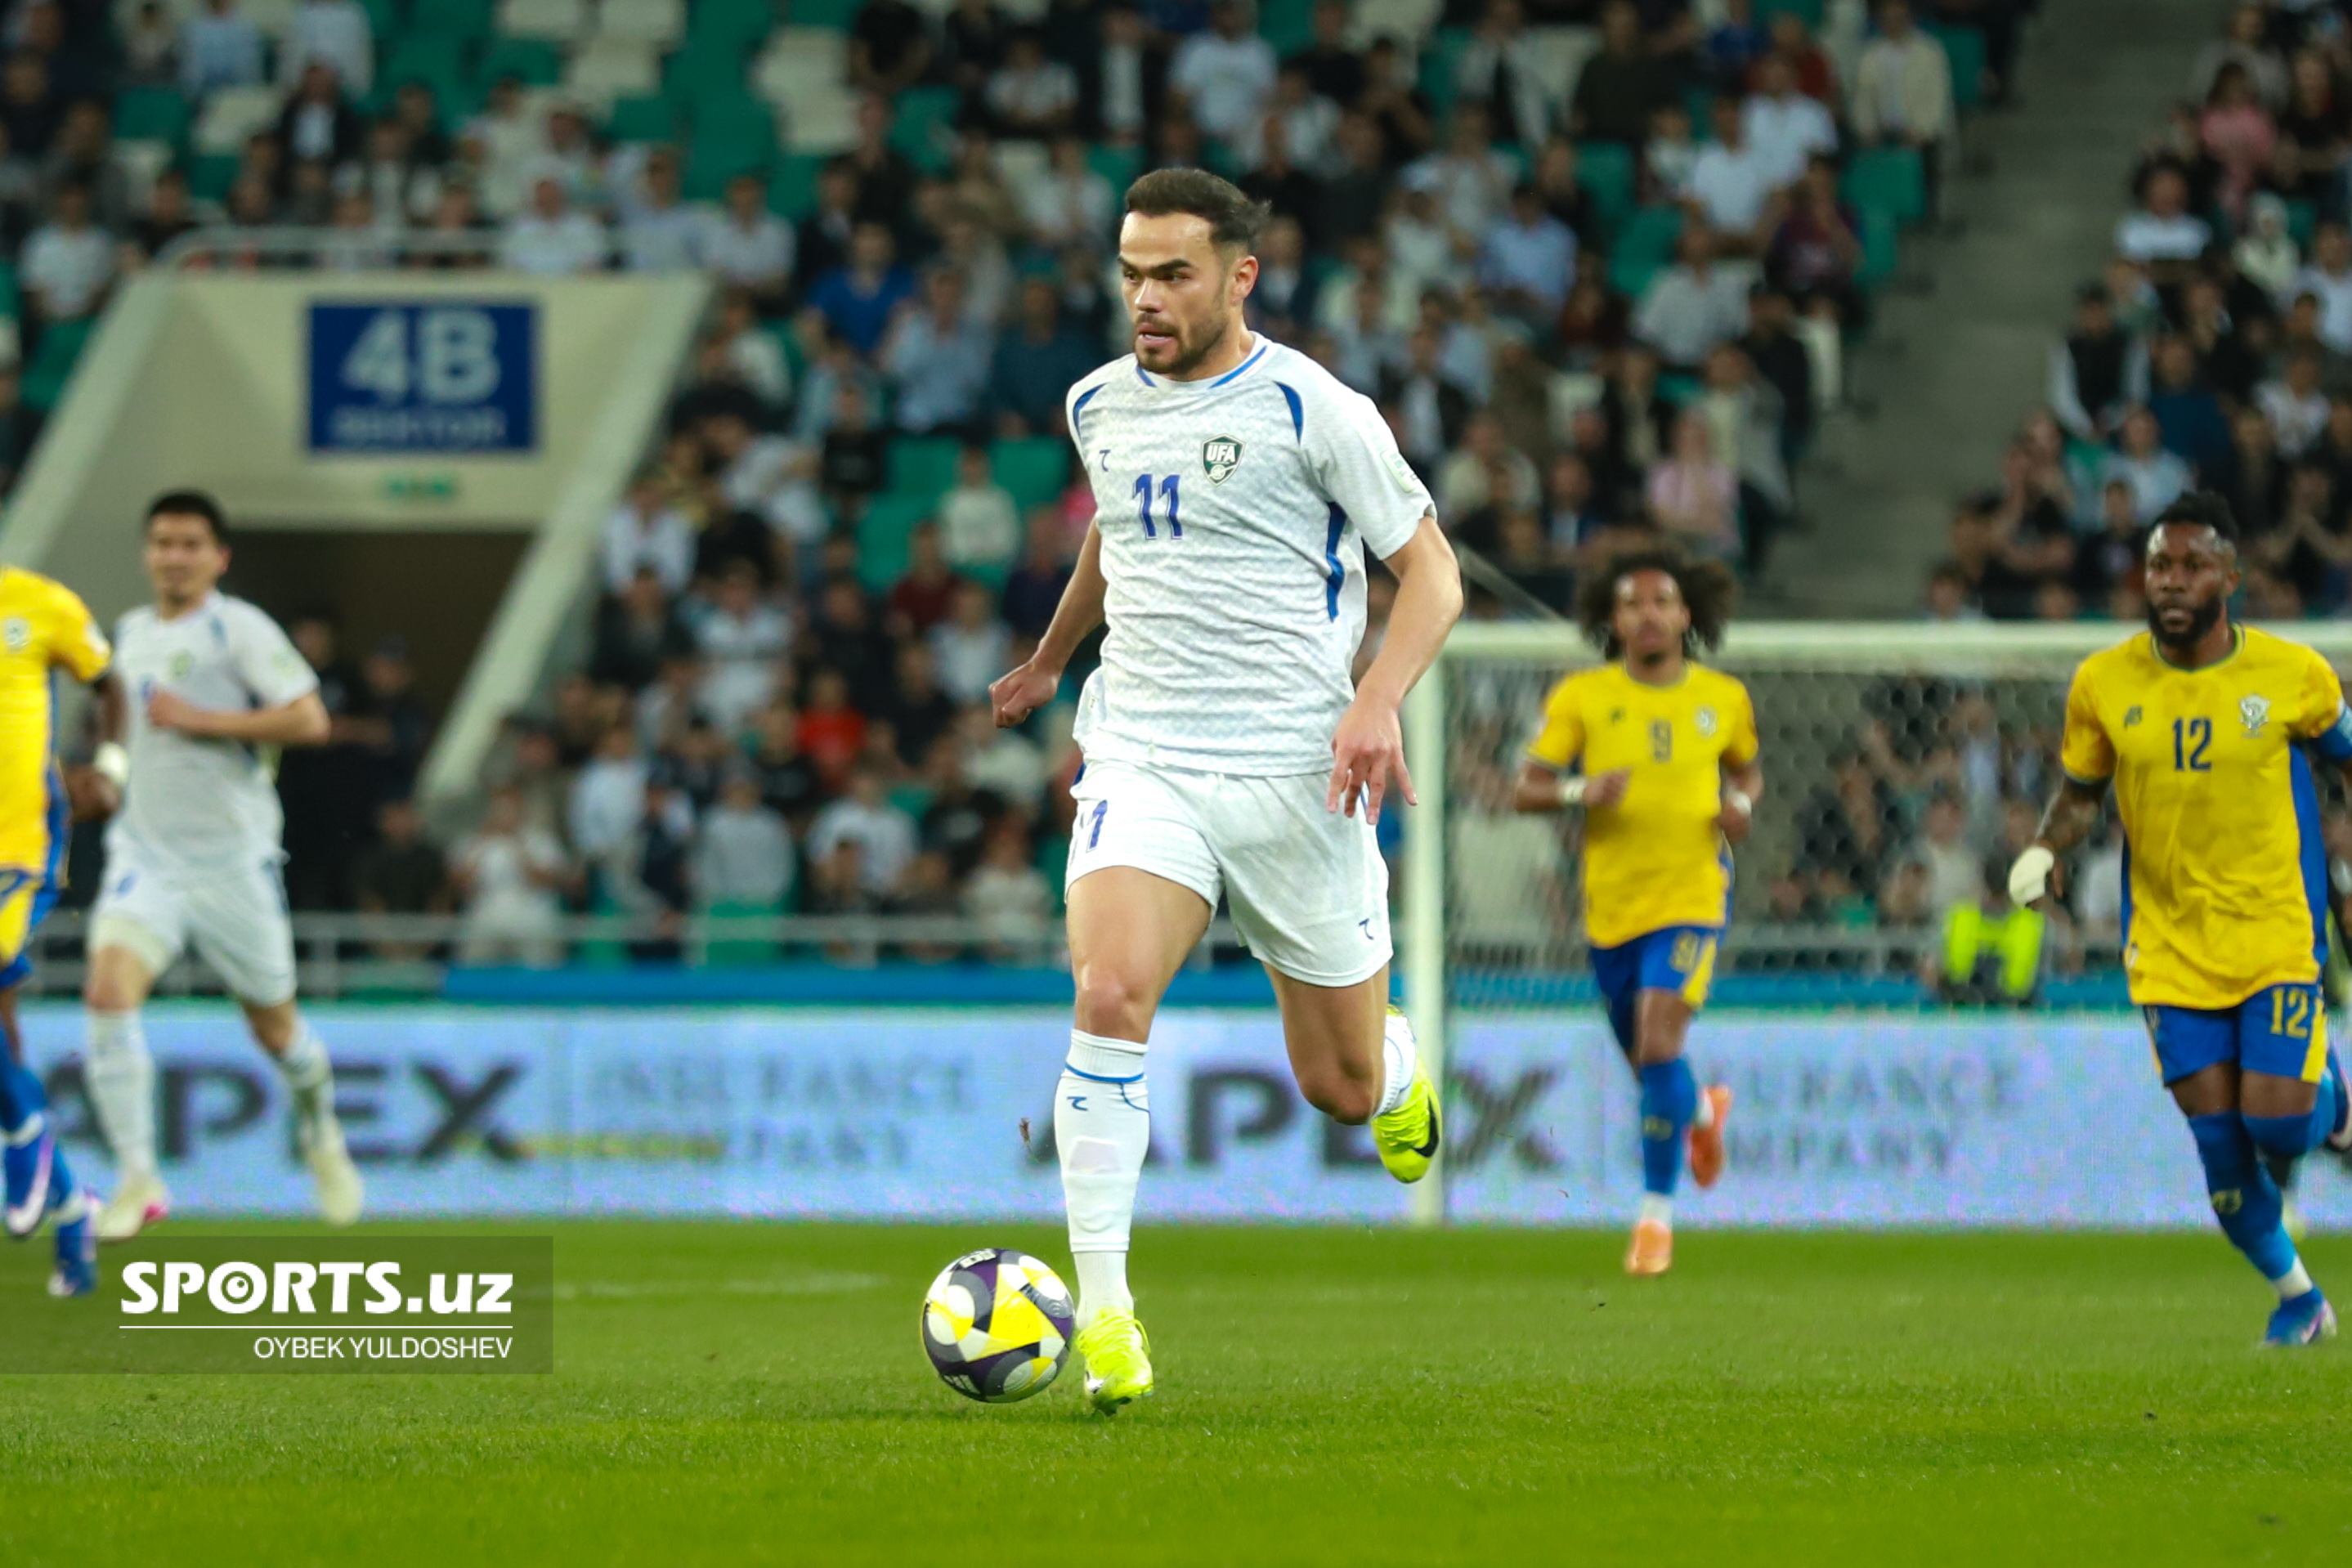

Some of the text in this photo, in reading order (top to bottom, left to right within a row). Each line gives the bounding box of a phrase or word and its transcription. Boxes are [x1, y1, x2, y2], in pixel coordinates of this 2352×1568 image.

[338, 309, 502, 403] 4B
[1207, 445, 1235, 463] UFA
[1132, 473, 1183, 540] 11
[2173, 717, 2212, 772] 12
[2270, 986, 2308, 1038] 12
